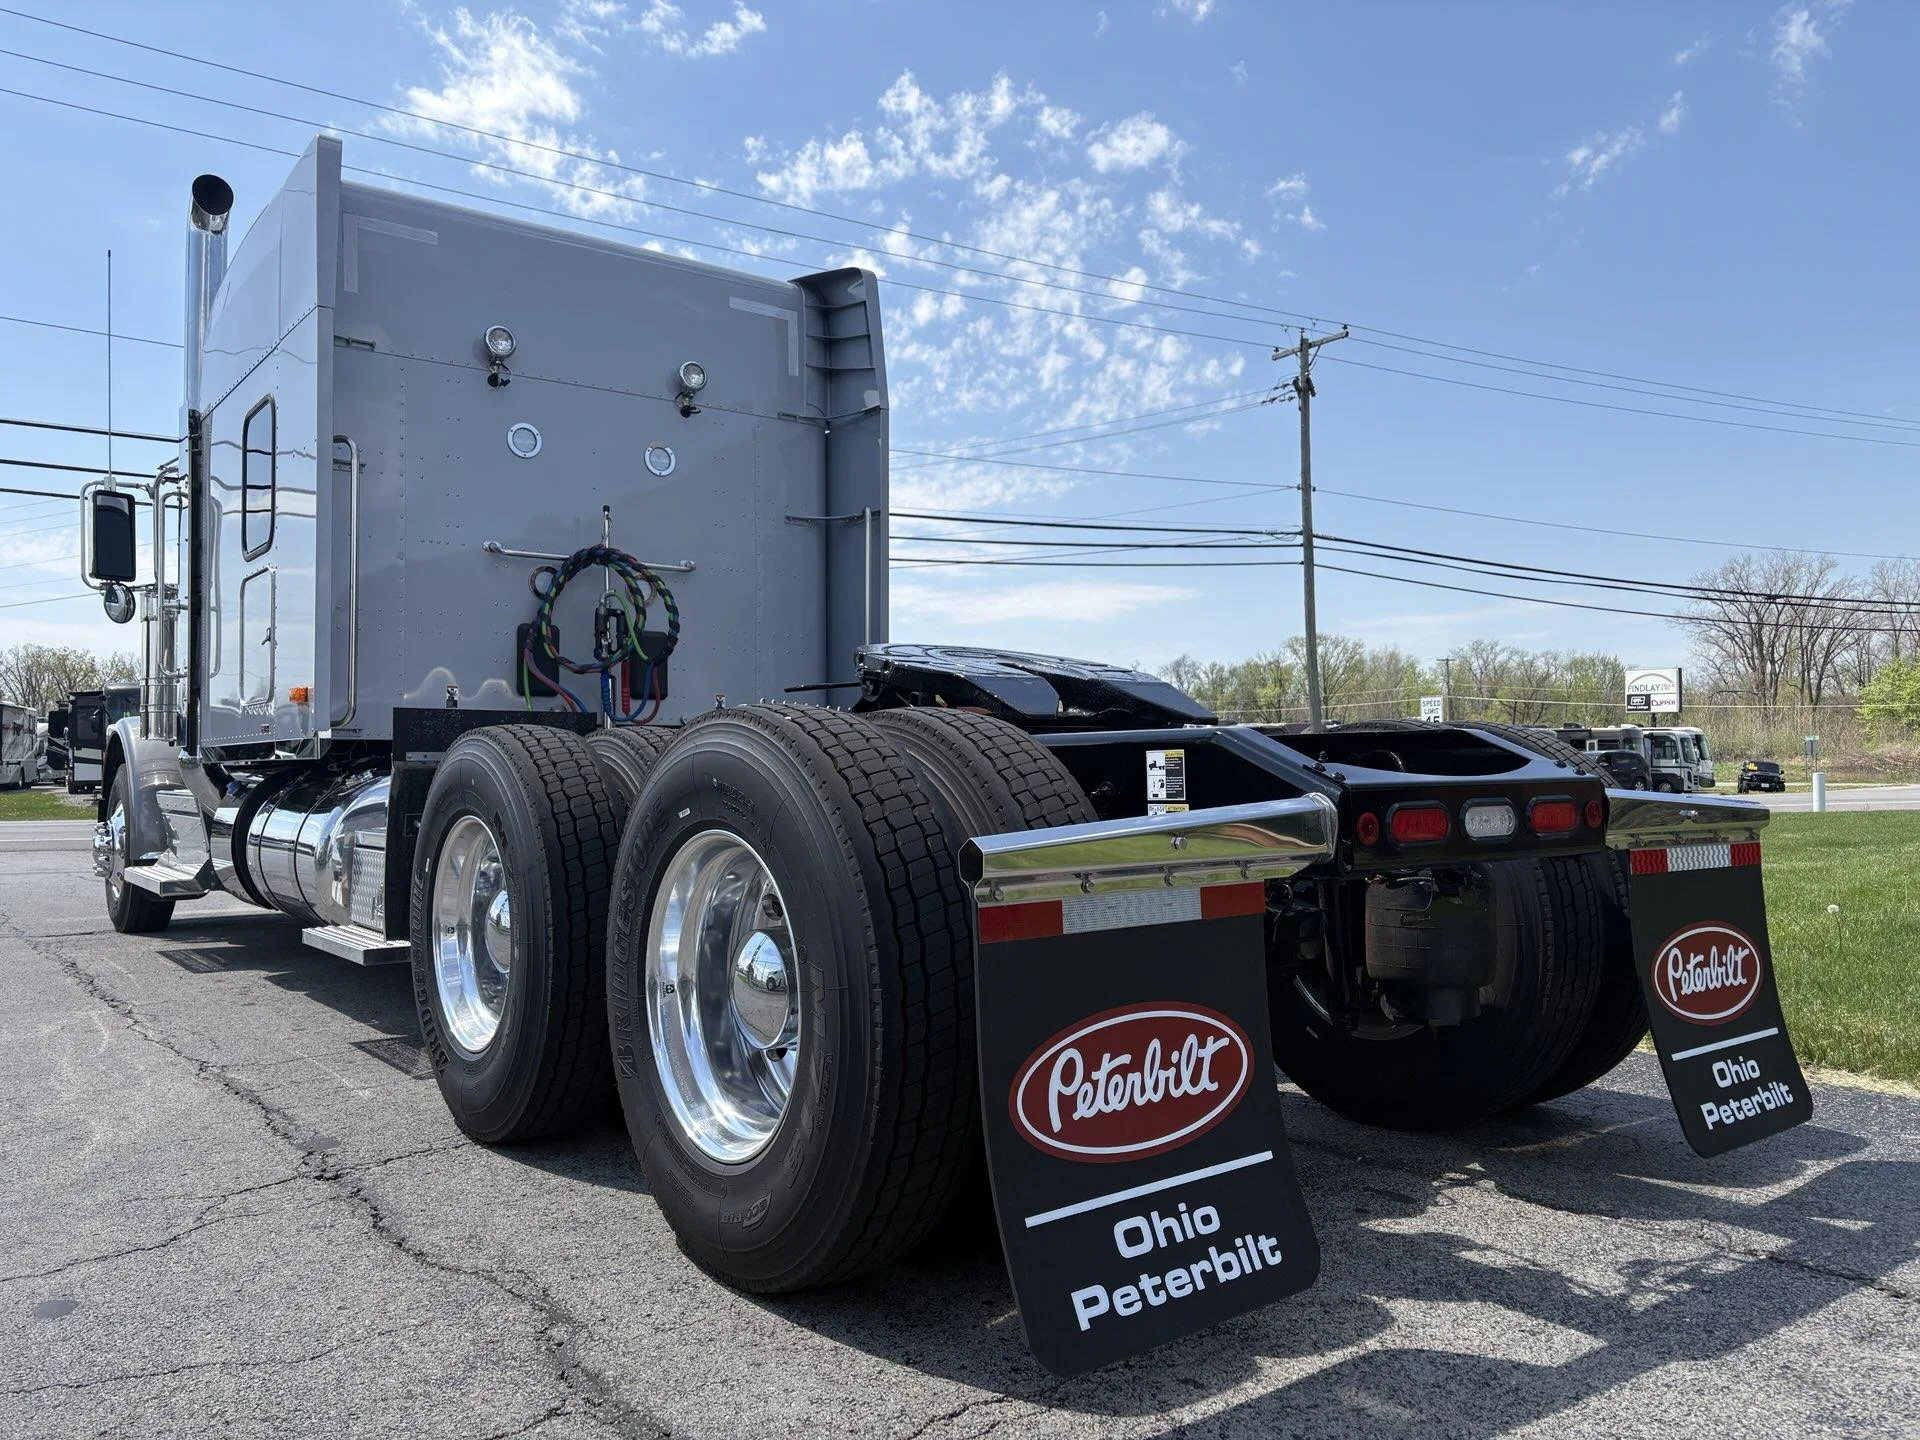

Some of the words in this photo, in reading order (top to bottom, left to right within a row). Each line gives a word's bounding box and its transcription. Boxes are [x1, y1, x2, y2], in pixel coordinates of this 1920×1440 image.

[1422, 699, 1441, 707] SPEED
[1627, 683, 1660, 693] FINDLAY
[1667, 945, 1750, 1002] Peterbilt
[1047, 1033, 1230, 1133] Peterbilt
[1712, 1056, 1760, 1088] Ohio
[1700, 1082, 1793, 1130] Peterbilt
[1113, 1202, 1221, 1259] Ohio
[1070, 1234, 1282, 1332] Peterbilt
